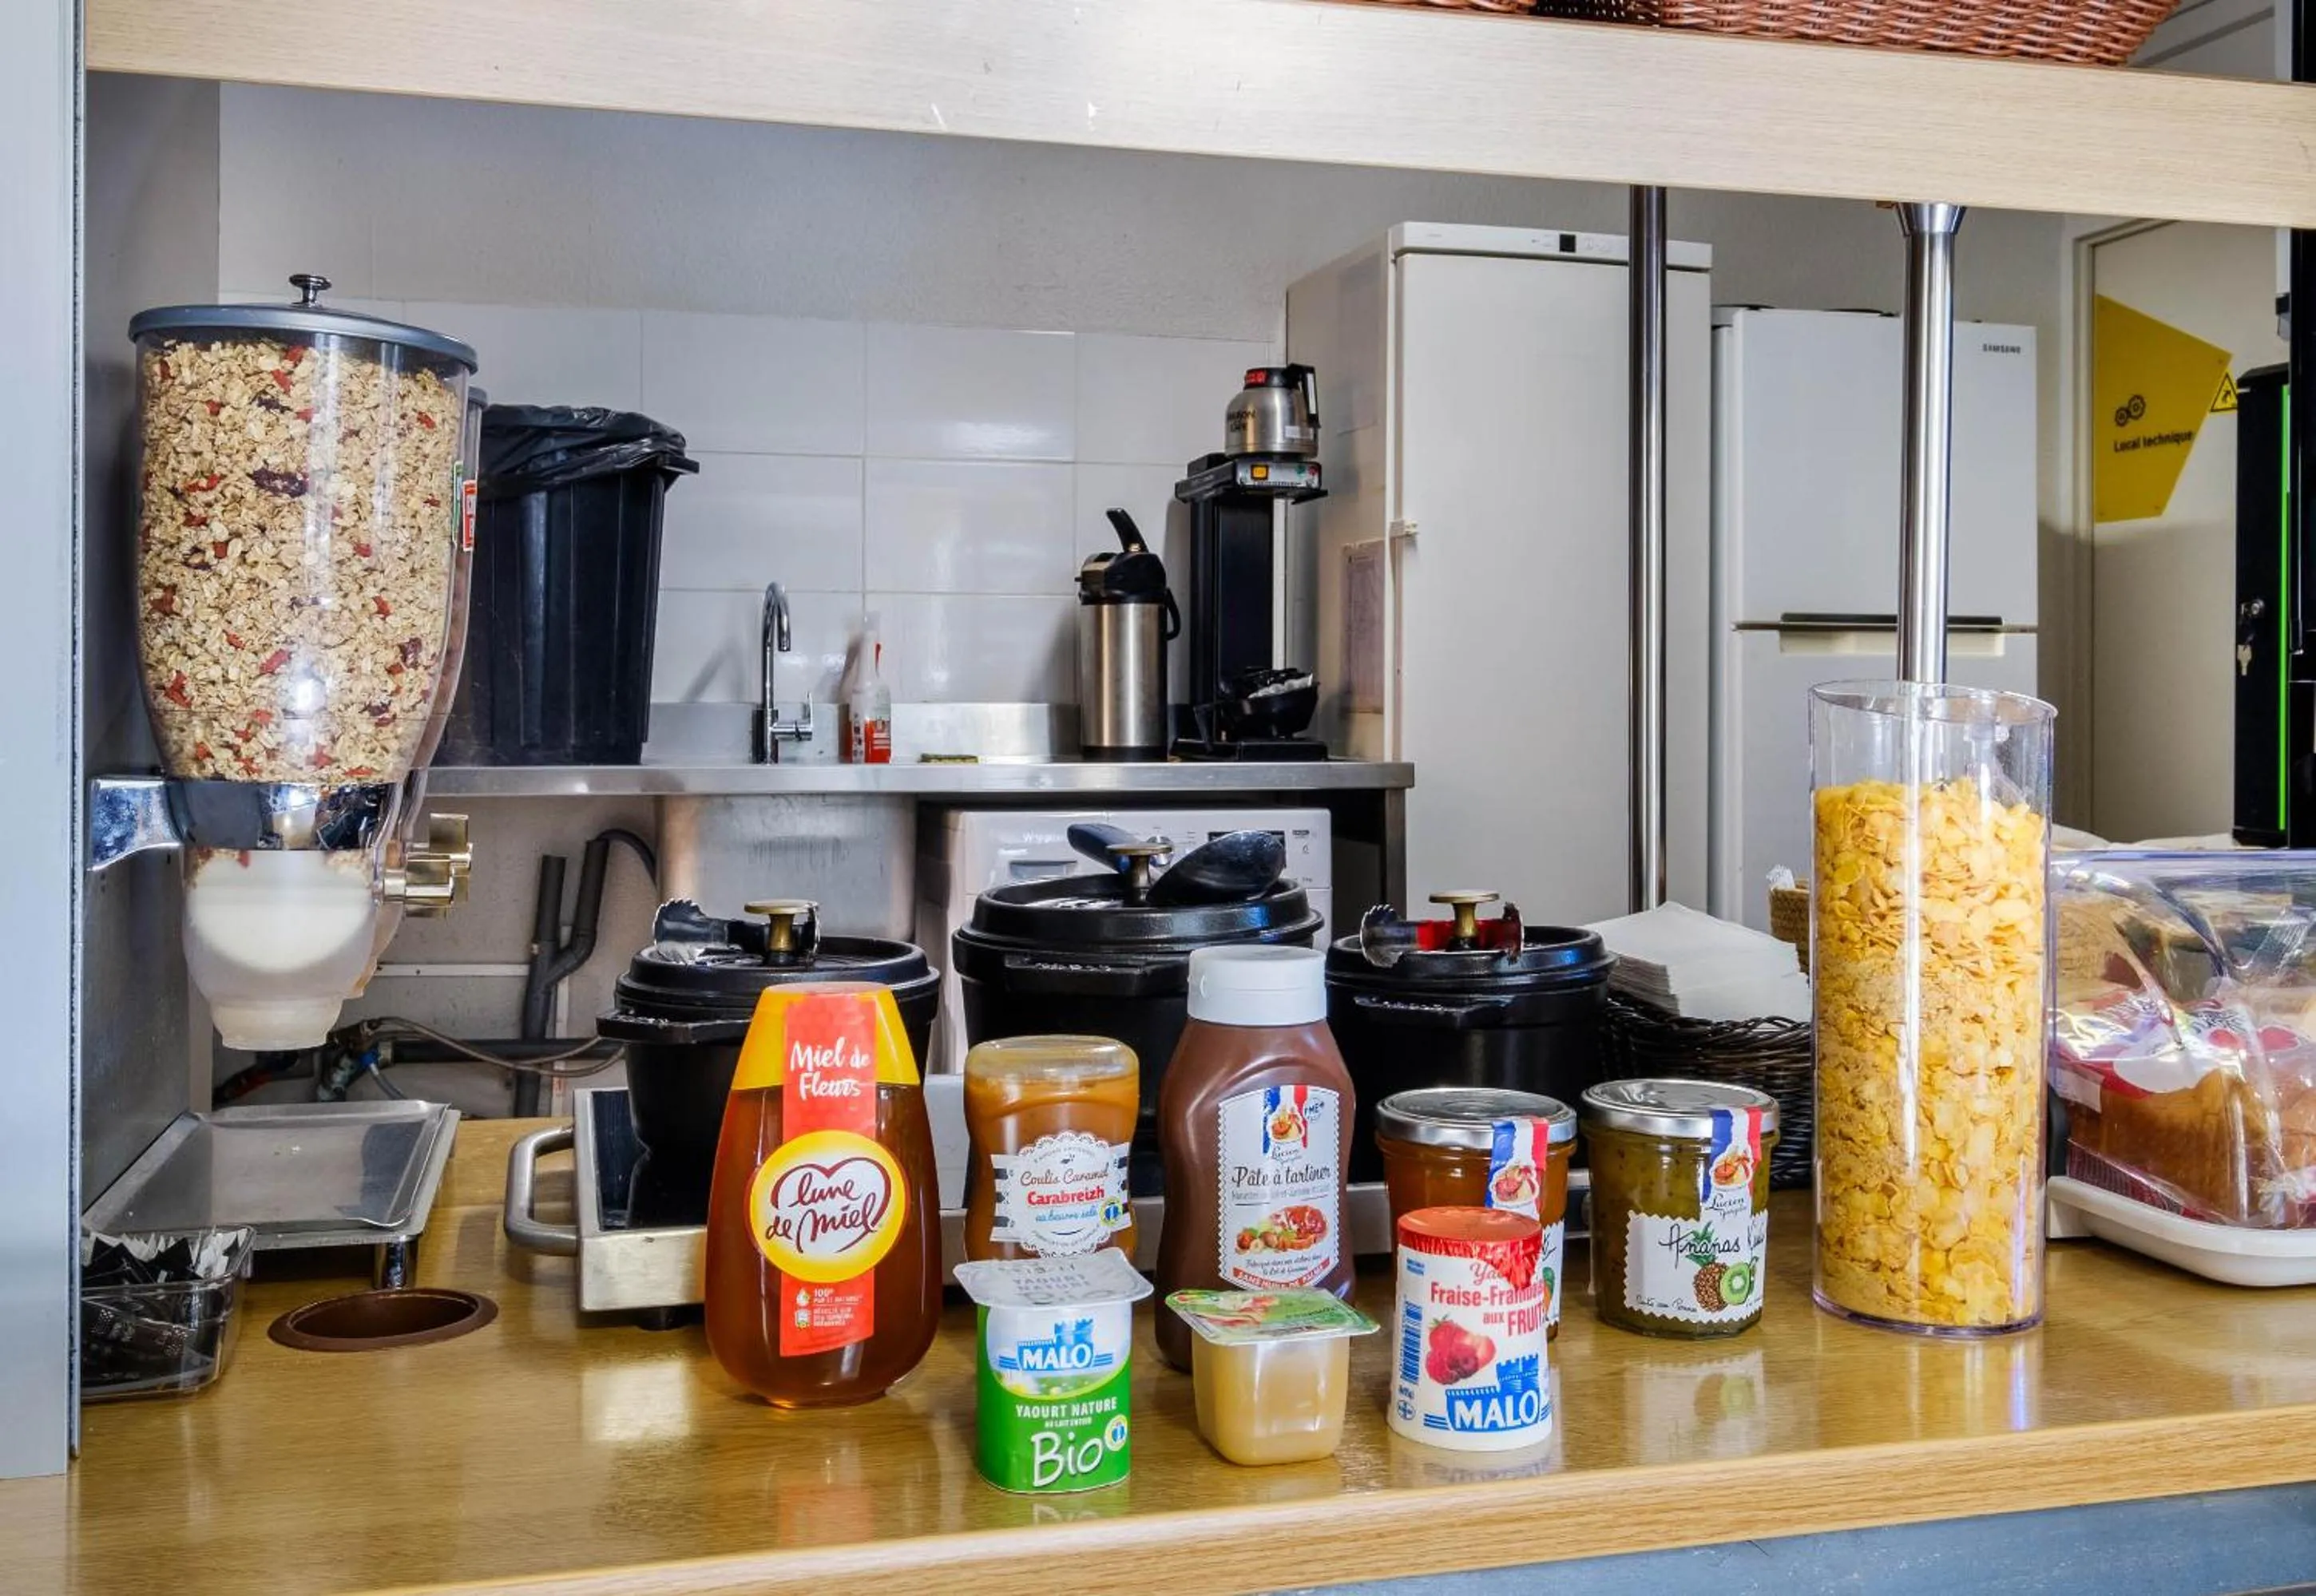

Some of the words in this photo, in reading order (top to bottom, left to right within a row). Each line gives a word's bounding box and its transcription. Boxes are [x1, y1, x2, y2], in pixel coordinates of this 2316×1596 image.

[2113, 436, 2141, 453] Local
[2143, 431, 2193, 448] technique
[789, 1036, 846, 1071] Miel
[850, 1044, 870, 1069] de
[799, 1071, 862, 1101] Fleurs
[1020, 1169, 1059, 1186] Coulis
[1063, 1162, 1109, 1185] Caramel
[1231, 1166, 1269, 1188] Pâte
[1273, 1168, 1283, 1185] à
[1285, 1164, 1331, 1184] tartiner
[1027, 1185, 1105, 1206] Carabreizh
[765, 1216, 793, 1240] de
[1657, 1223, 1741, 1269] Ananas
[1483, 1312, 1505, 1324] aux
[1507, 1302, 1546, 1337] FRUIT
[1022, 1343, 1092, 1370] MALO
[1015, 1404, 1068, 1419] YAOURT
[1071, 1396, 1118, 1417] NATURE
[1454, 1389, 1539, 1430] MALO
[1030, 1431, 1104, 1487] Bio
